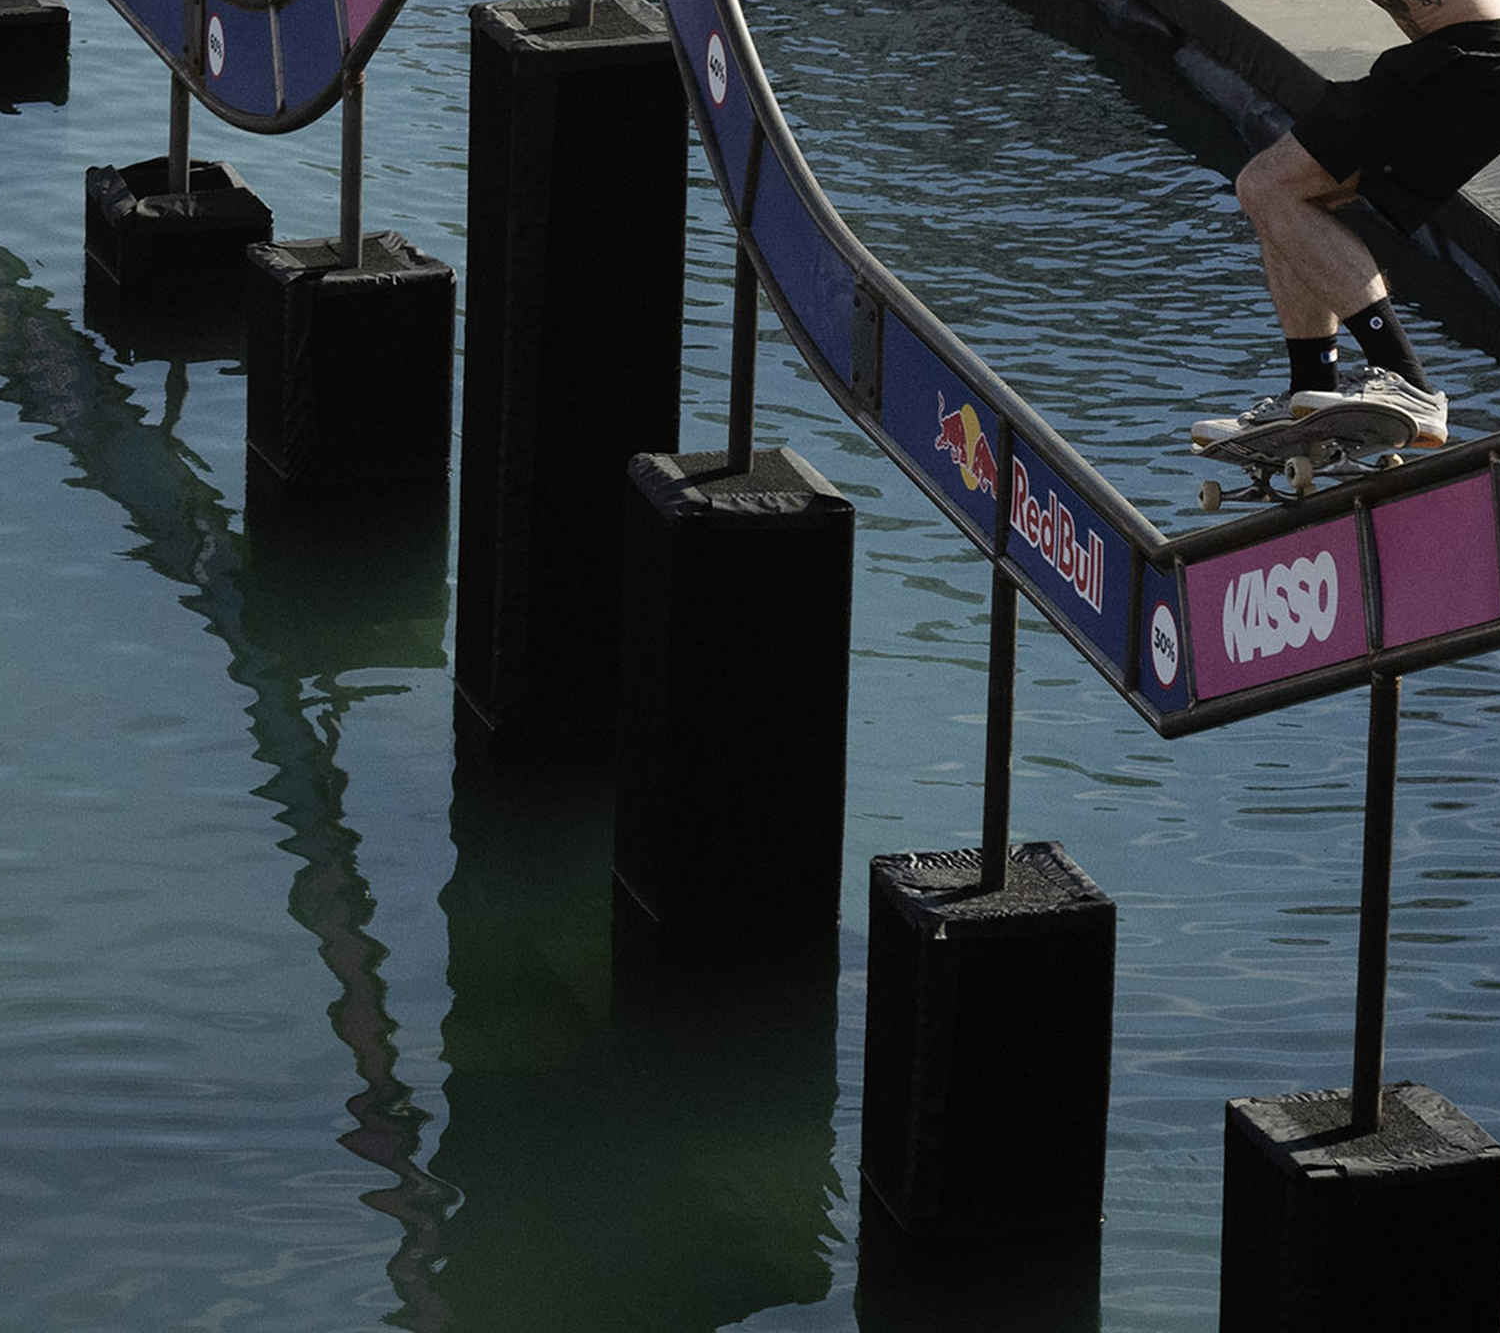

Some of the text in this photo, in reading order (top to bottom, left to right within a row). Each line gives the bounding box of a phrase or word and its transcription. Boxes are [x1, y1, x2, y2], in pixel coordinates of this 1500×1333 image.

[708, 55, 728, 85] 40%
[1010, 455, 1105, 614] Red Bull
[1151, 625, 1178, 663] 30%
[1221, 549, 1339, 664] KASSO
